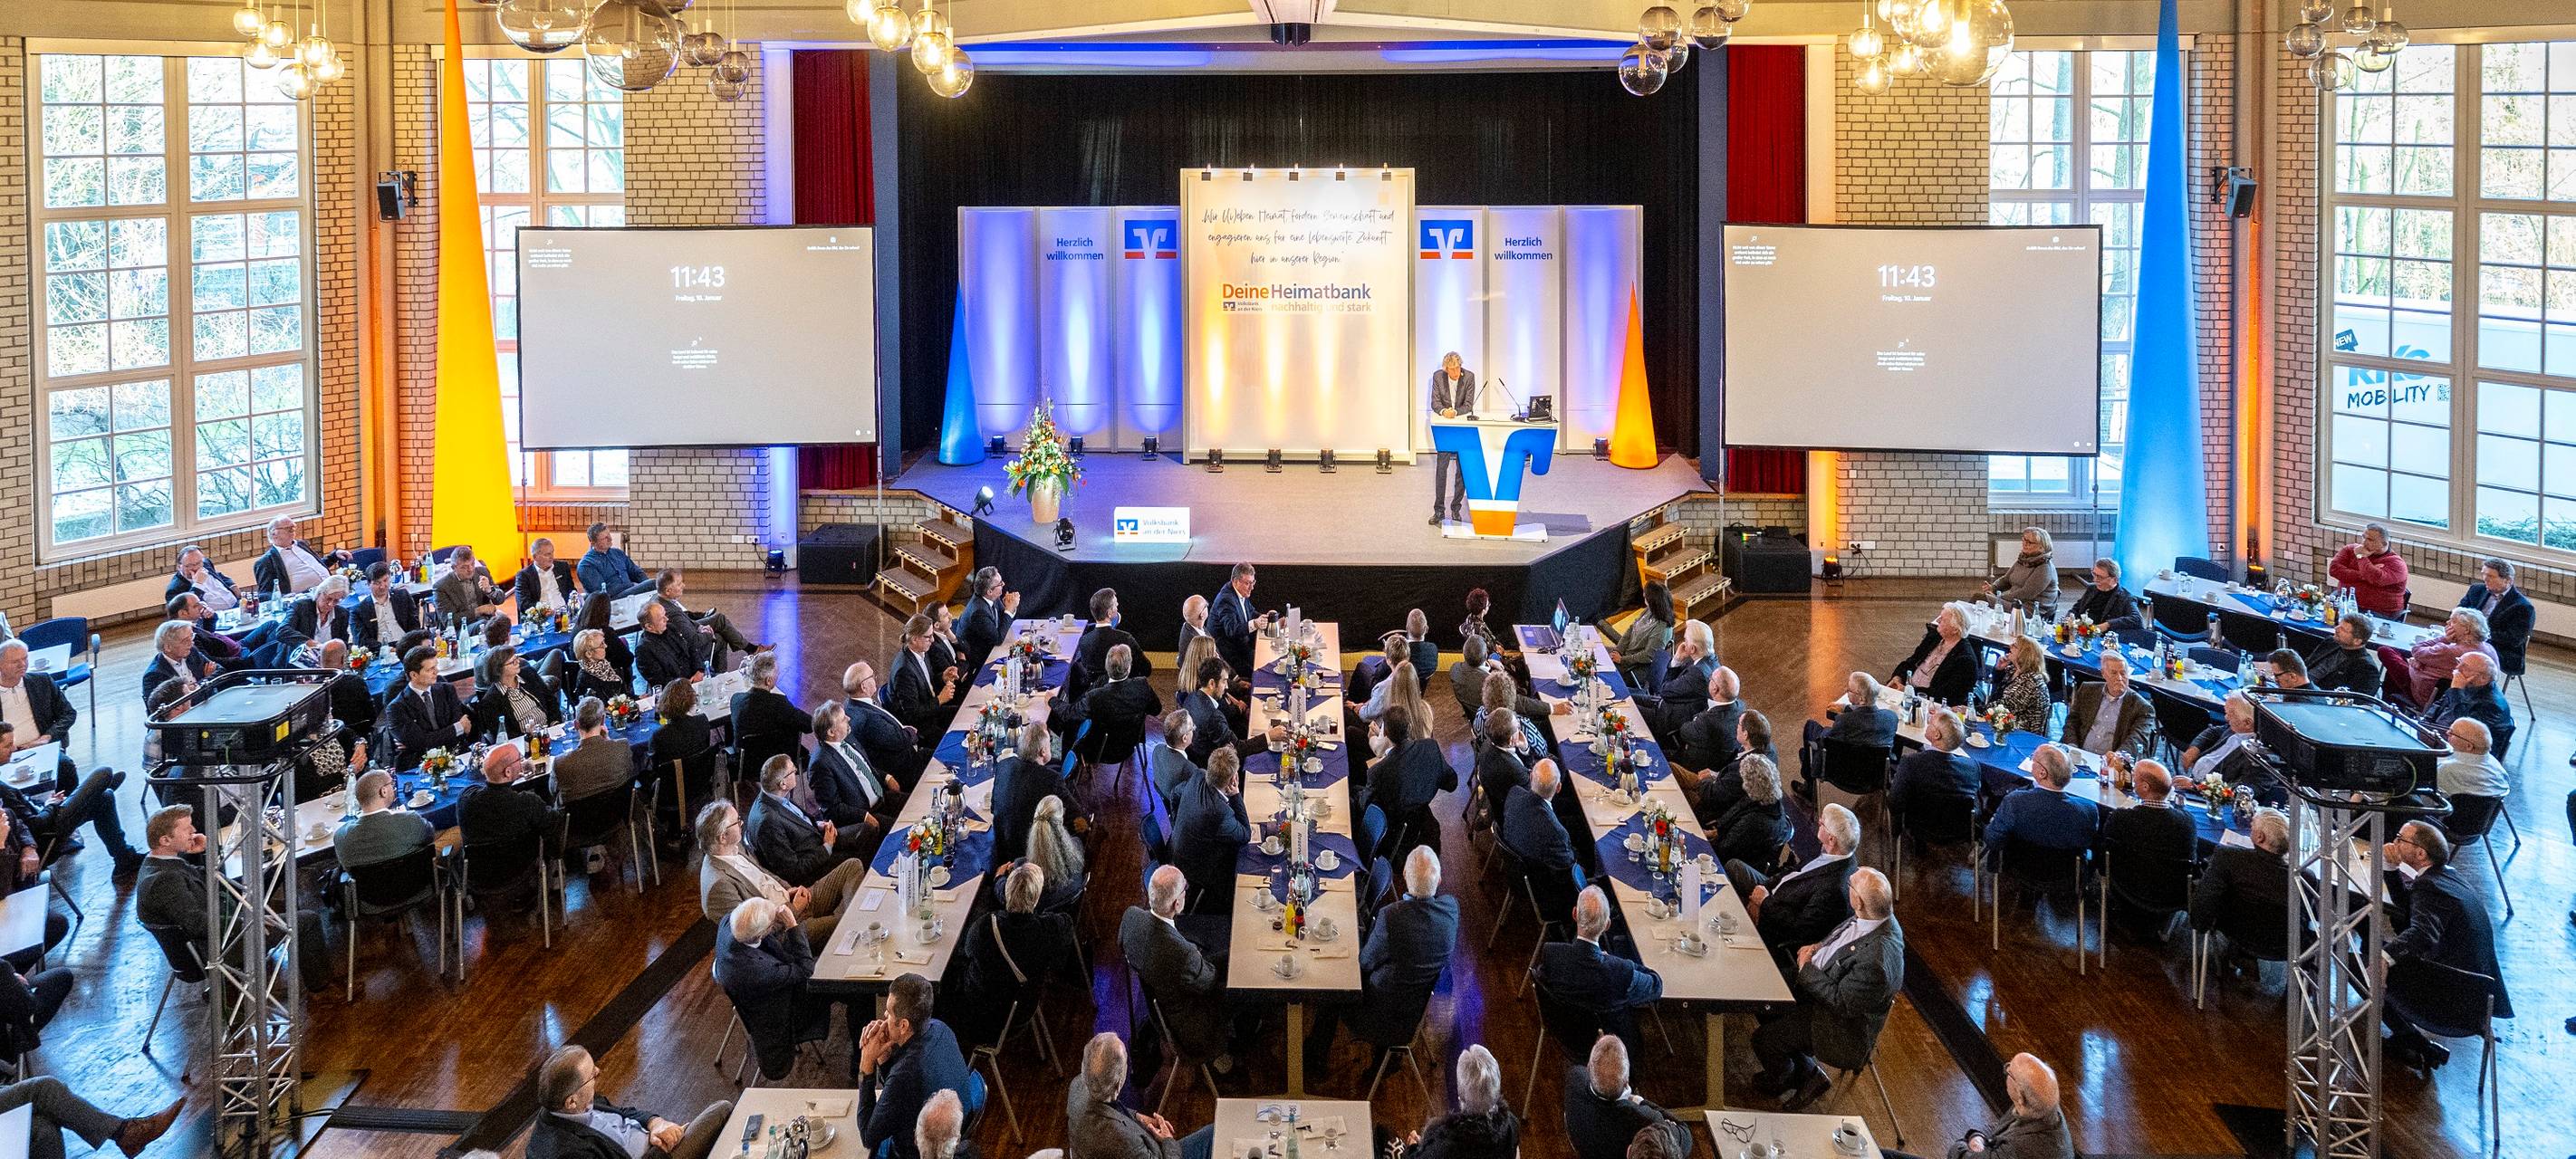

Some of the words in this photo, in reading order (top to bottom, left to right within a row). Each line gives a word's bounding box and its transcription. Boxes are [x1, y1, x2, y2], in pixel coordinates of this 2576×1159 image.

[1056, 237, 1093, 247] Herzlich
[1208, 233, 1252, 246] engagieren
[1504, 236, 1542, 247] Herzlich
[1046, 251, 1104, 261] willkommen
[1251, 252, 1264, 264] hier
[1495, 250, 1553, 260] willkommen
[670, 266, 725, 288] 11:43
[1878, 265, 1936, 288] 11:43
[1271, 302, 1322, 313] nachhaltig
[1347, 302, 1371, 311] stark
[2348, 384, 2431, 409] MOBLITY
